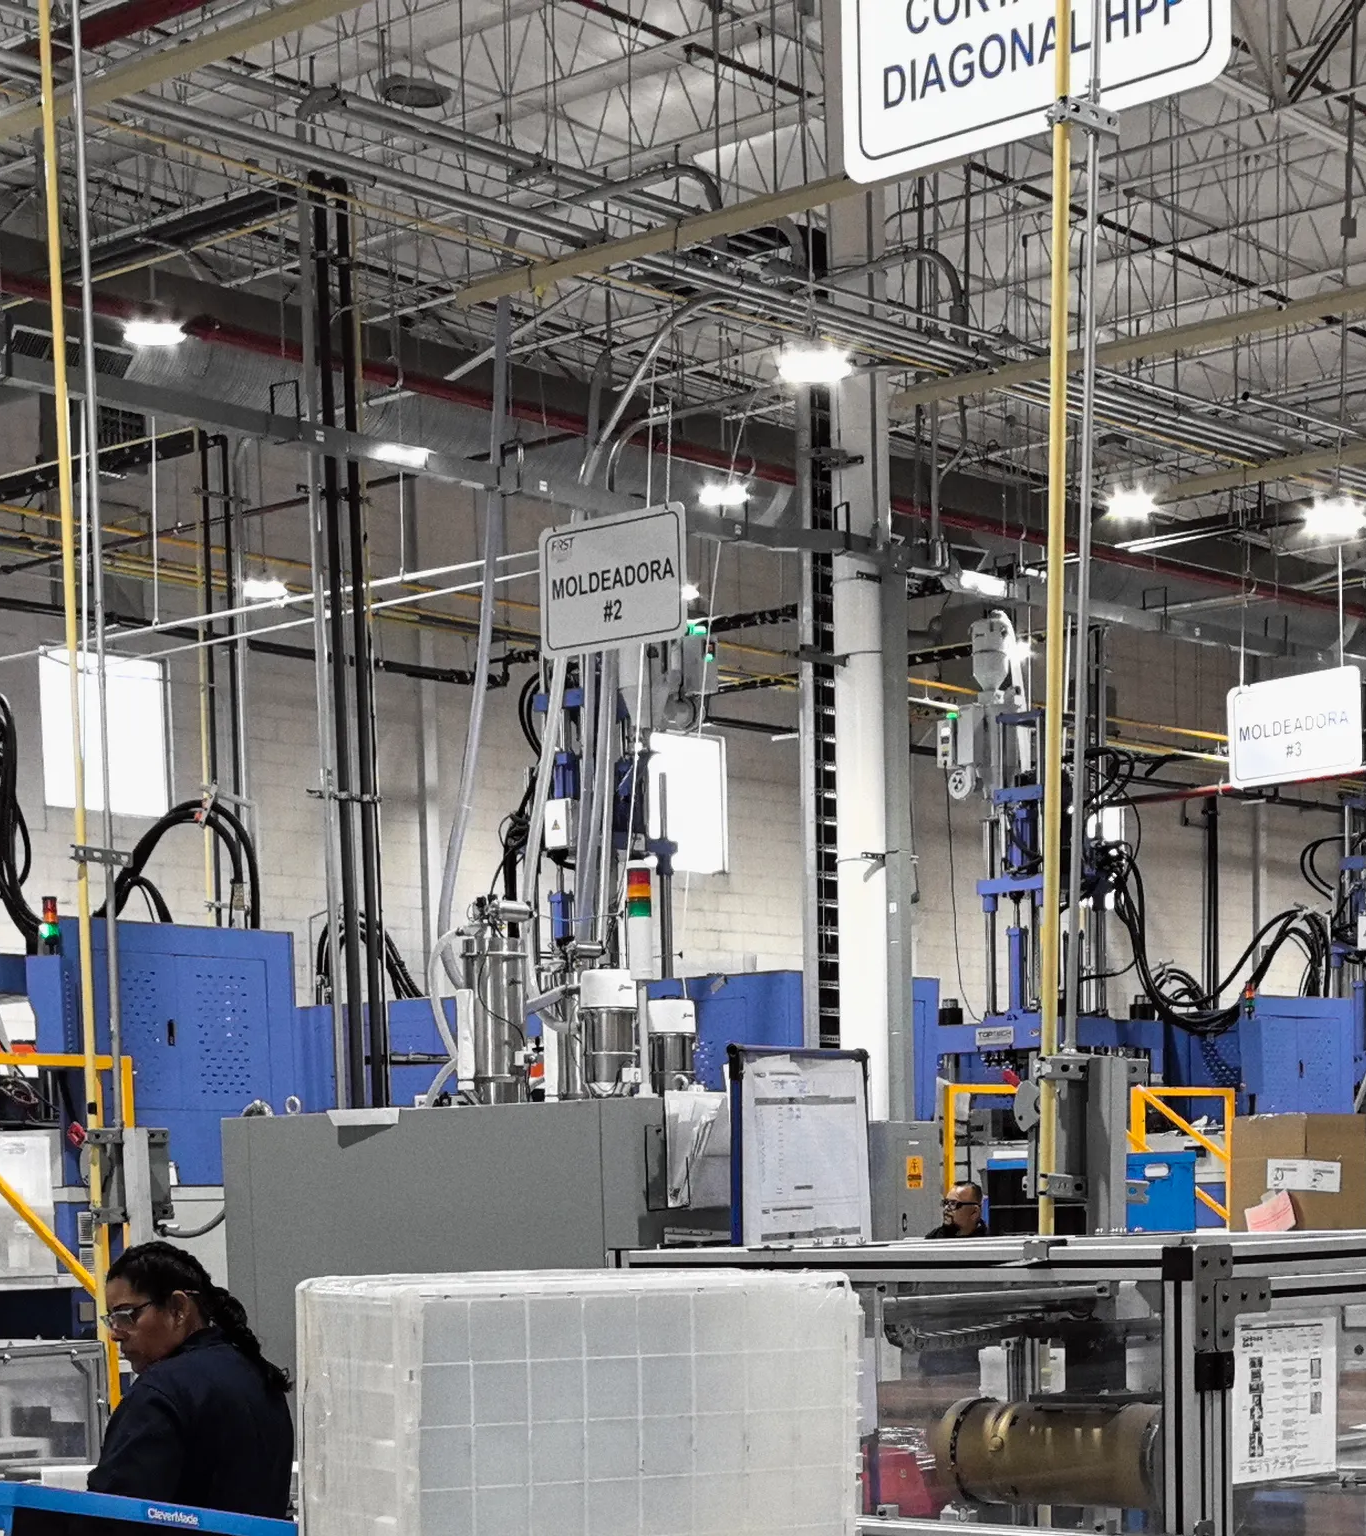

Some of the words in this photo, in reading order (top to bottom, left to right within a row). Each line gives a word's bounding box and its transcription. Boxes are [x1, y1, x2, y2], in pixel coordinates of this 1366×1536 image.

[883, 10, 1091, 109] DIAGONAL
[552, 557, 675, 600] MOLDEADORA
[603, 599, 623, 622] #2
[1239, 711, 1349, 742] MOLDEADORA
[1286, 741, 1302, 758] #3
[147, 1508, 199, 1526] CleverMade
